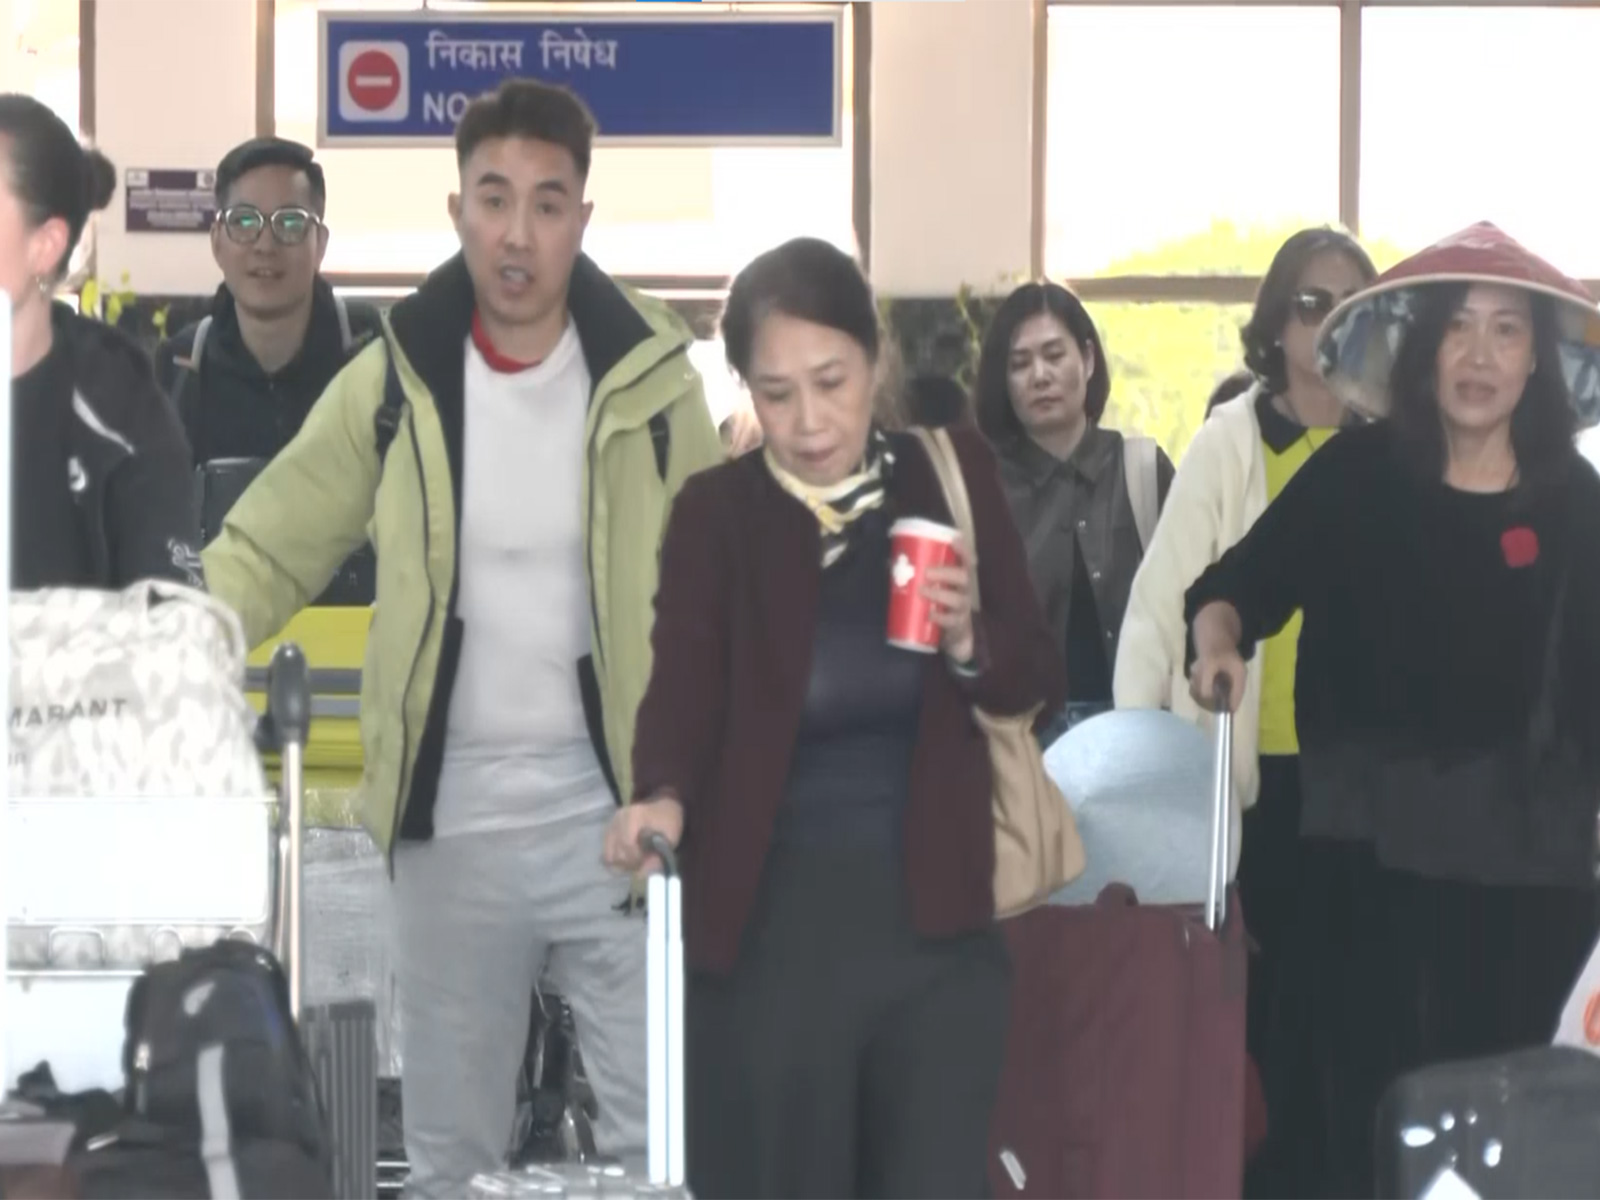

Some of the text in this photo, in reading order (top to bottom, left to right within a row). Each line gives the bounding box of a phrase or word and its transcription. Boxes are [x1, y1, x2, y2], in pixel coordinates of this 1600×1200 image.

[425, 28, 618, 69] निकास निषेध
[423, 92, 469, 123] NO
